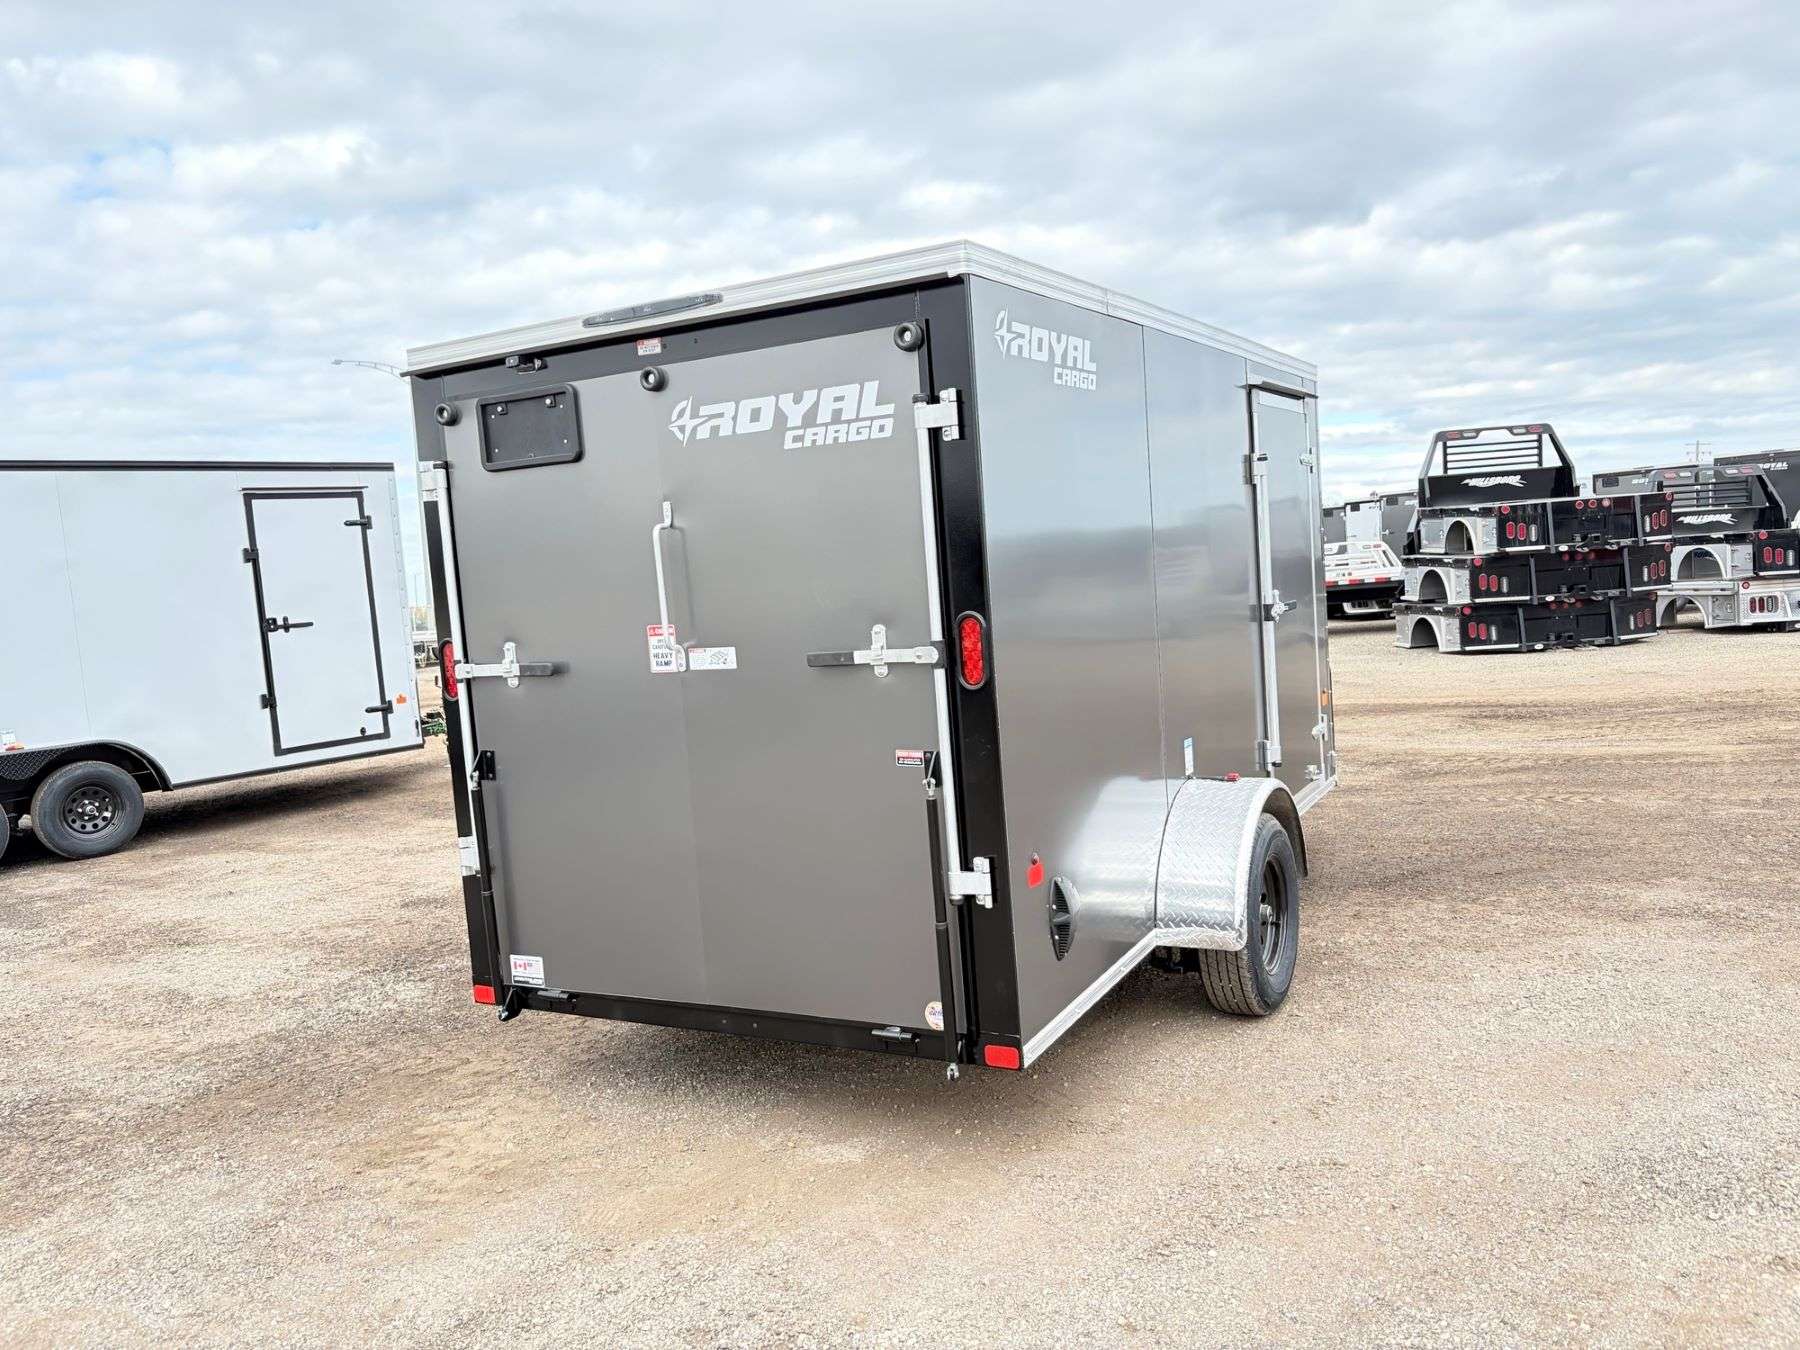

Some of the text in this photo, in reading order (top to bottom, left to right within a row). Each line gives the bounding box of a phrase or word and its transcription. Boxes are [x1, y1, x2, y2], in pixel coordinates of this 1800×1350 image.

[1010, 321, 1097, 372] ROYAL
[1053, 366, 1097, 391] CARGO
[696, 380, 896, 440] ROYAL
[783, 417, 895, 450] CARGO
